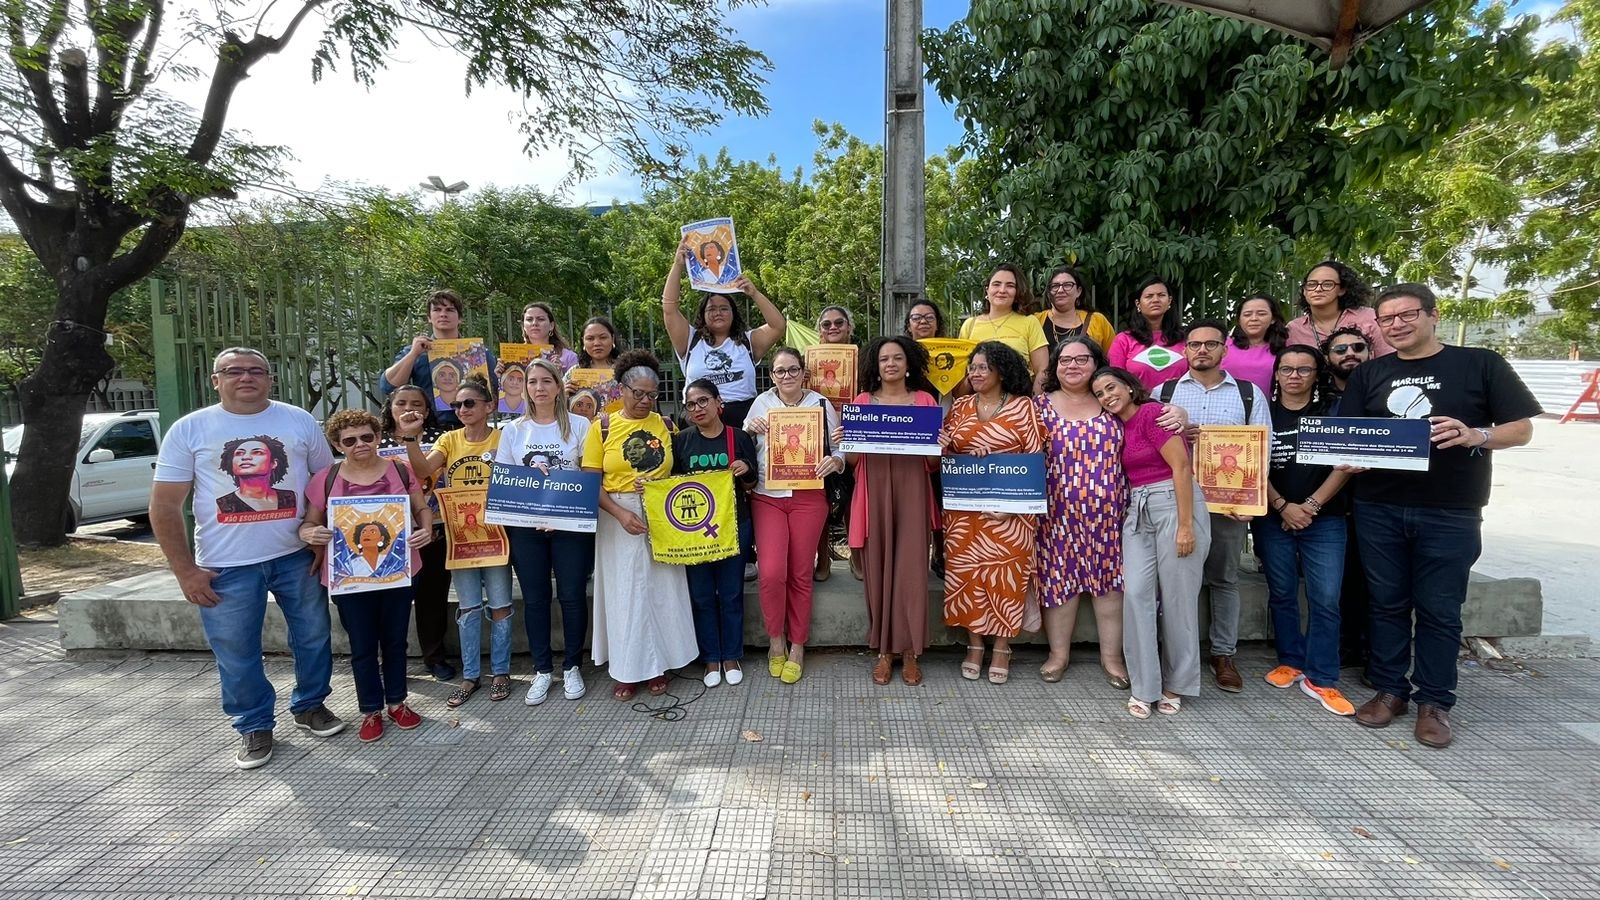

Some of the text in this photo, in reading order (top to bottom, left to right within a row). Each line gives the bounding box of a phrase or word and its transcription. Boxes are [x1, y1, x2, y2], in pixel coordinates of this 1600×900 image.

[1392, 376, 1434, 387] MARIELLE
[842, 413, 913, 423] Marielle Franco
[1349, 427, 1390, 435] Franco
[690, 453, 728, 468] POVO
[493, 466, 510, 474] Rua
[942, 464, 1028, 474] Marielle Franco
[492, 474, 582, 492] Marielle Franco
[238, 511, 293, 522] ESQUECEREMOS!
